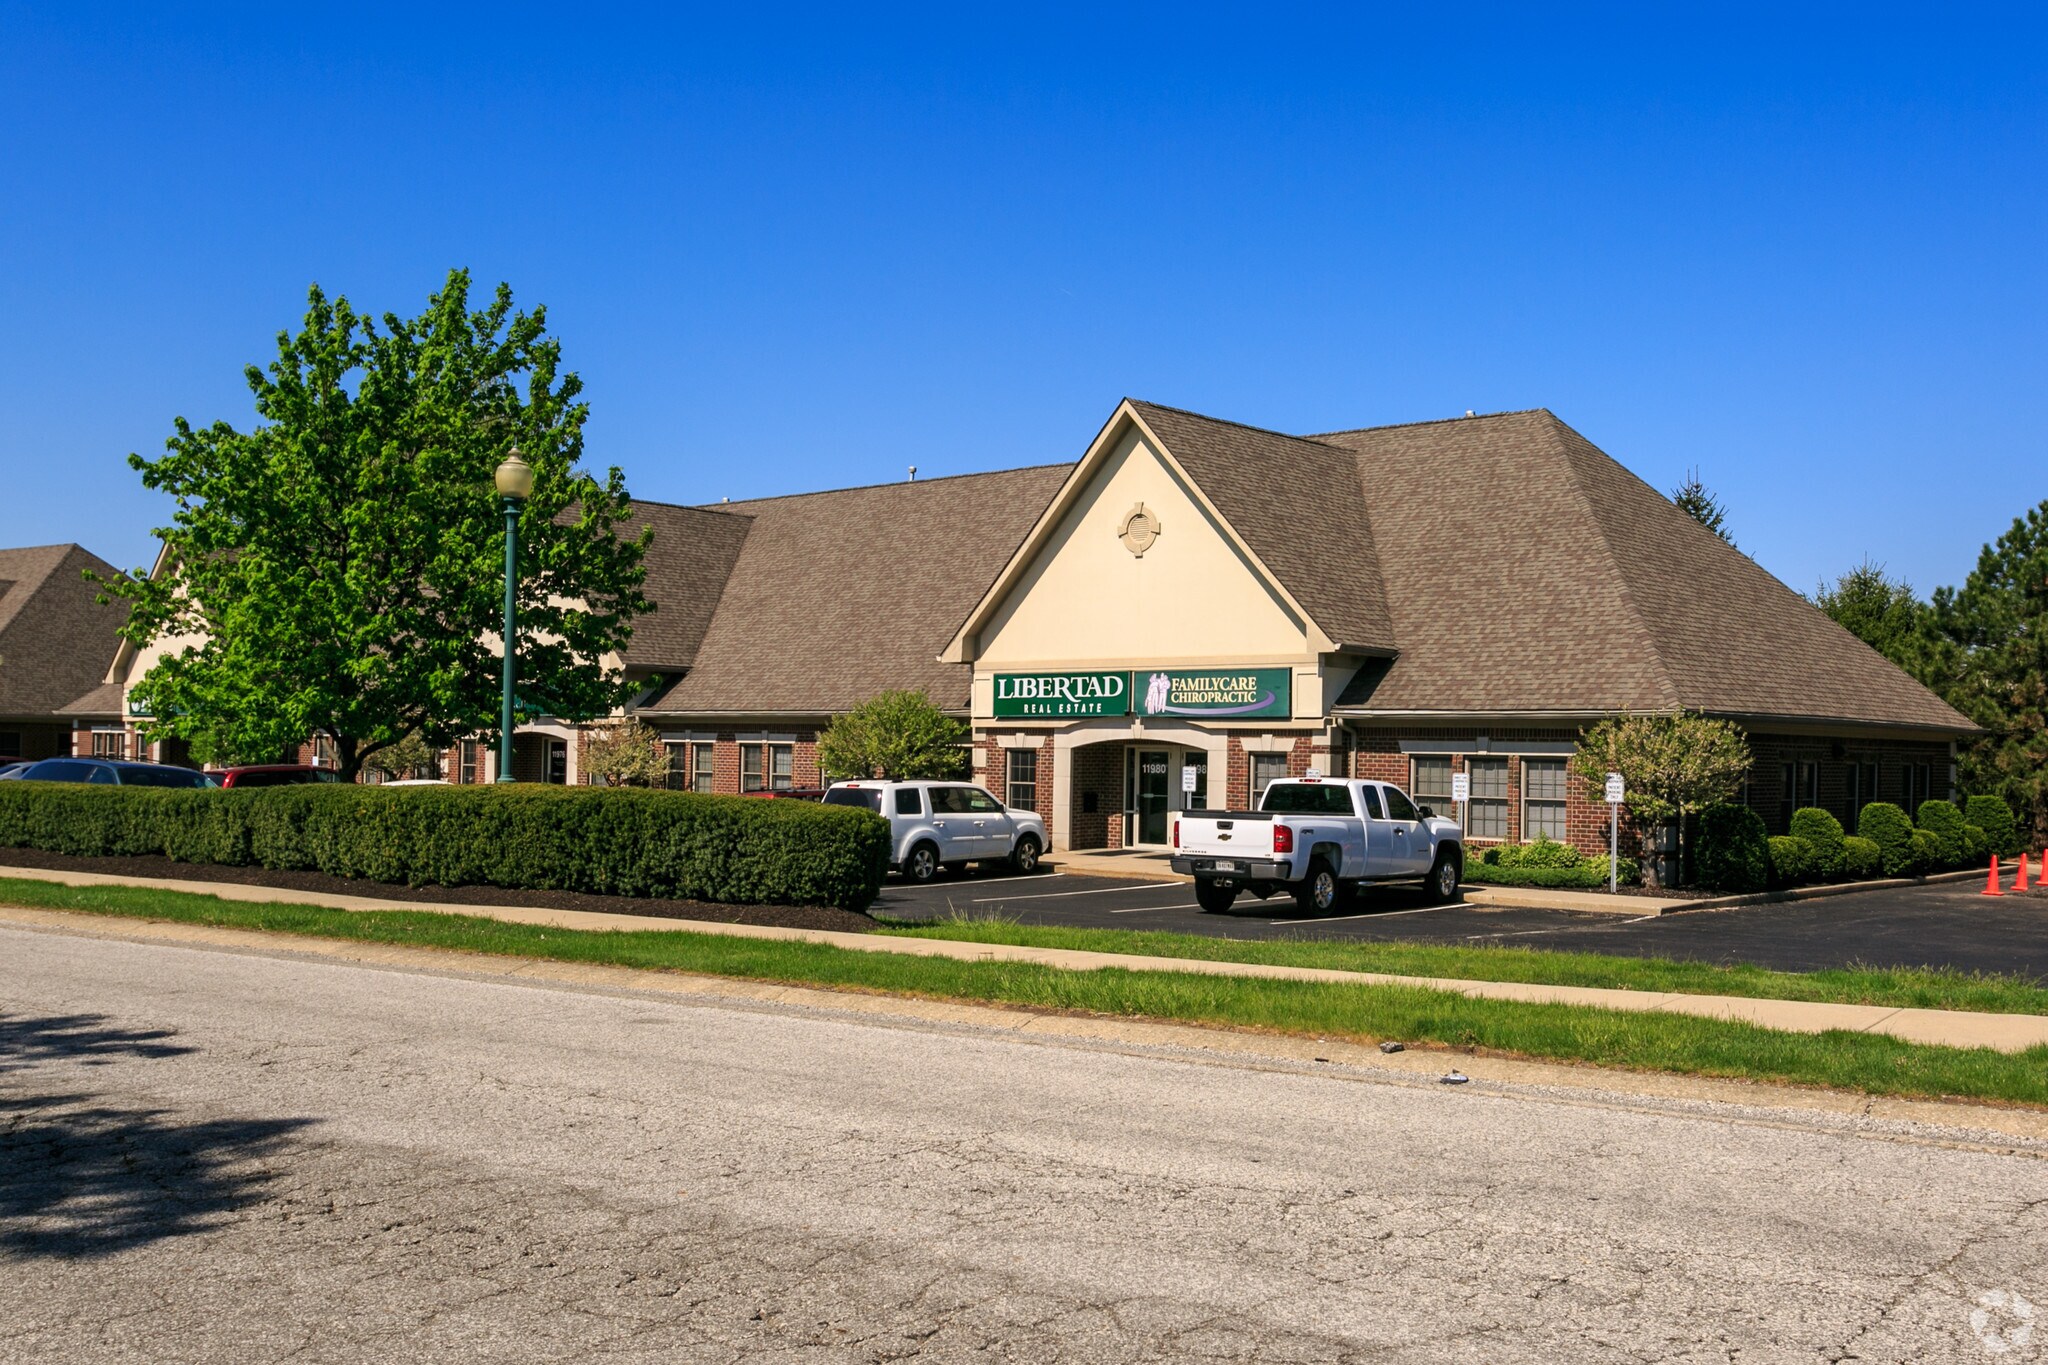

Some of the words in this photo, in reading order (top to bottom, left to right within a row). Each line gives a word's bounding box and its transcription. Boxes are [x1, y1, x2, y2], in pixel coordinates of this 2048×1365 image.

[998, 676, 1124, 703] LIBERTAD
[1171, 677, 1257, 692] FAMILYCARE
[1170, 691, 1257, 703] CHIROPRACTIC
[1023, 703, 1052, 714] REAL
[1058, 702, 1102, 713] ESTATE
[1142, 763, 1167, 774] 11980
